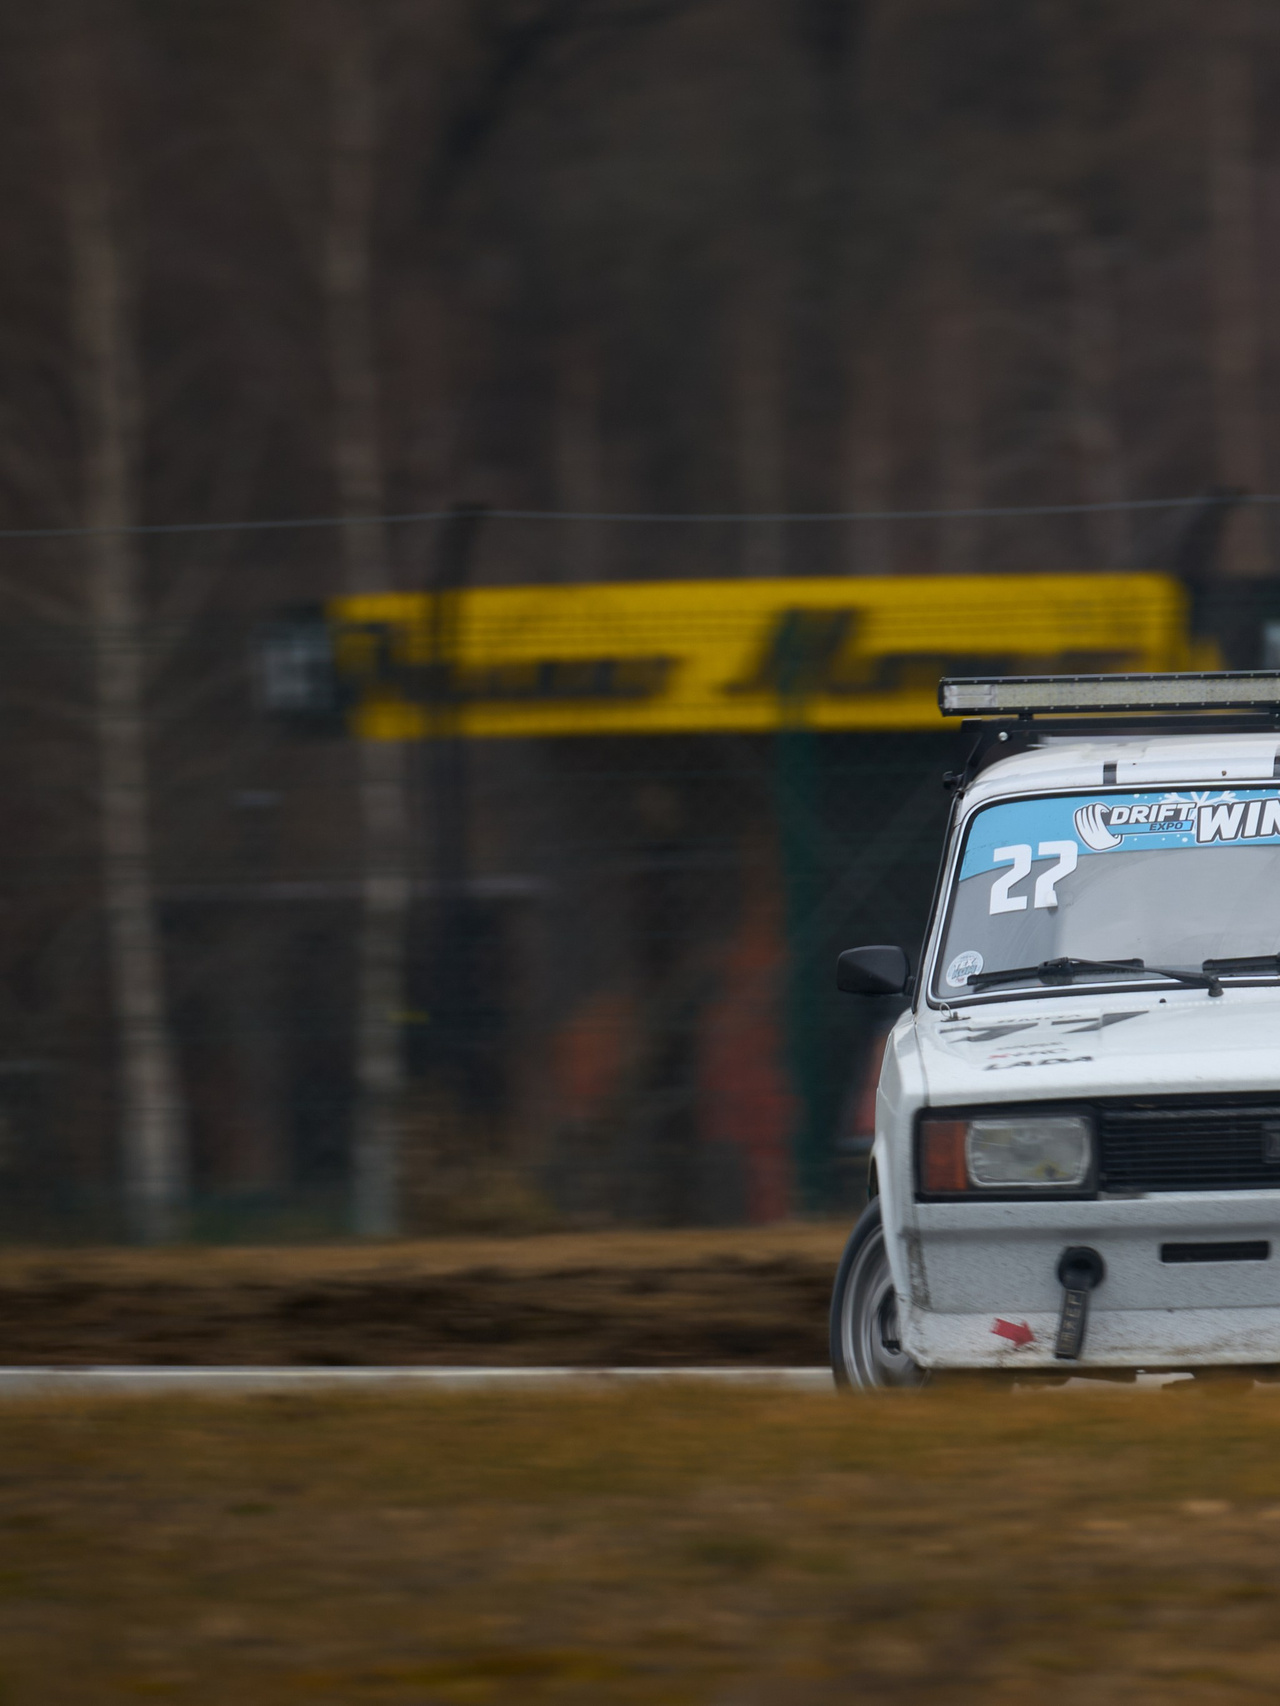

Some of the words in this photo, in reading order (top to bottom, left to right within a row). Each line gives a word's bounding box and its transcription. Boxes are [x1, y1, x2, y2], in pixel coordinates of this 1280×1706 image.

[1109, 802, 1197, 825] DRIFT
[1149, 821, 1184, 832] EXPO
[983, 1056, 1094, 1071] LADA
